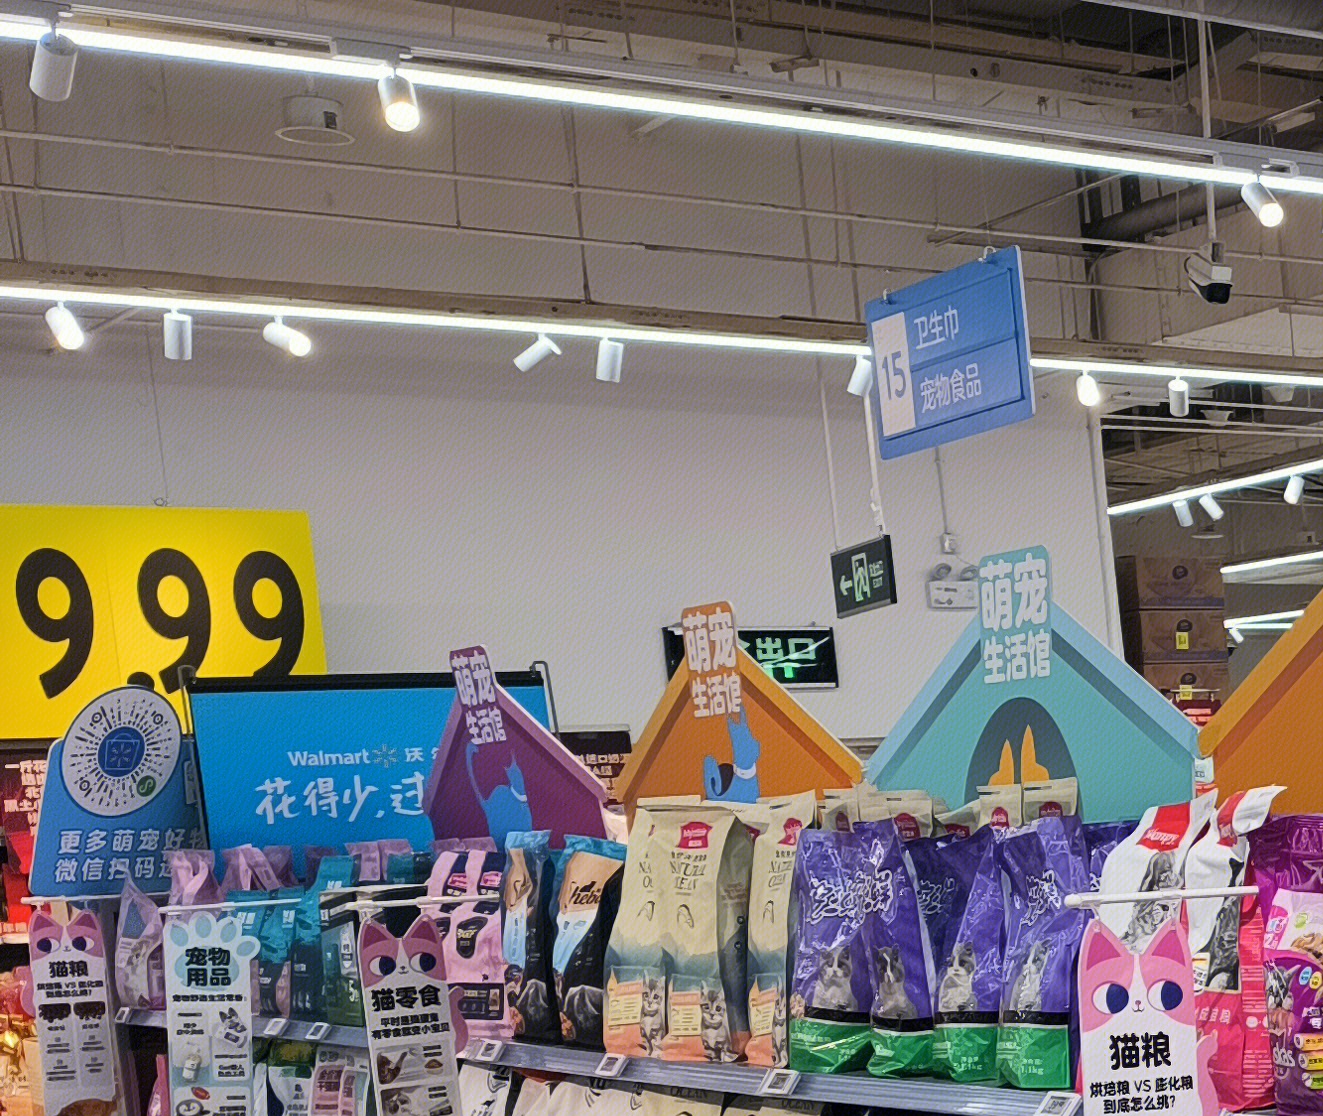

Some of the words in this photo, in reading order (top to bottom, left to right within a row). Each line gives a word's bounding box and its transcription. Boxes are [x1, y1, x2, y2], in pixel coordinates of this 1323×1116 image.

[914, 305, 959, 350] 卫生巾
[881, 350, 907, 402] 15
[920, 362, 982, 413] 宠物食品
[980, 553, 1048, 632] 萌宠
[682, 607, 737, 674] 萌宠
[983, 628, 1051, 684] 生活馆
[452, 650, 496, 707] 萌宠
[691, 673, 742, 718] 生活馆
[288, 749, 370, 767] Walmart
[49, 961, 89, 979] 猫粮
[186, 947, 231, 967] 宠物
[187, 967, 232, 988] 用品
[372, 984, 442, 1012] 猫零食
[1109, 1031, 1172, 1070] 猫粮
[1103, 1095, 1176, 1115] 到底怎么挑?
[1134, 1079, 1152, 1093] VS
